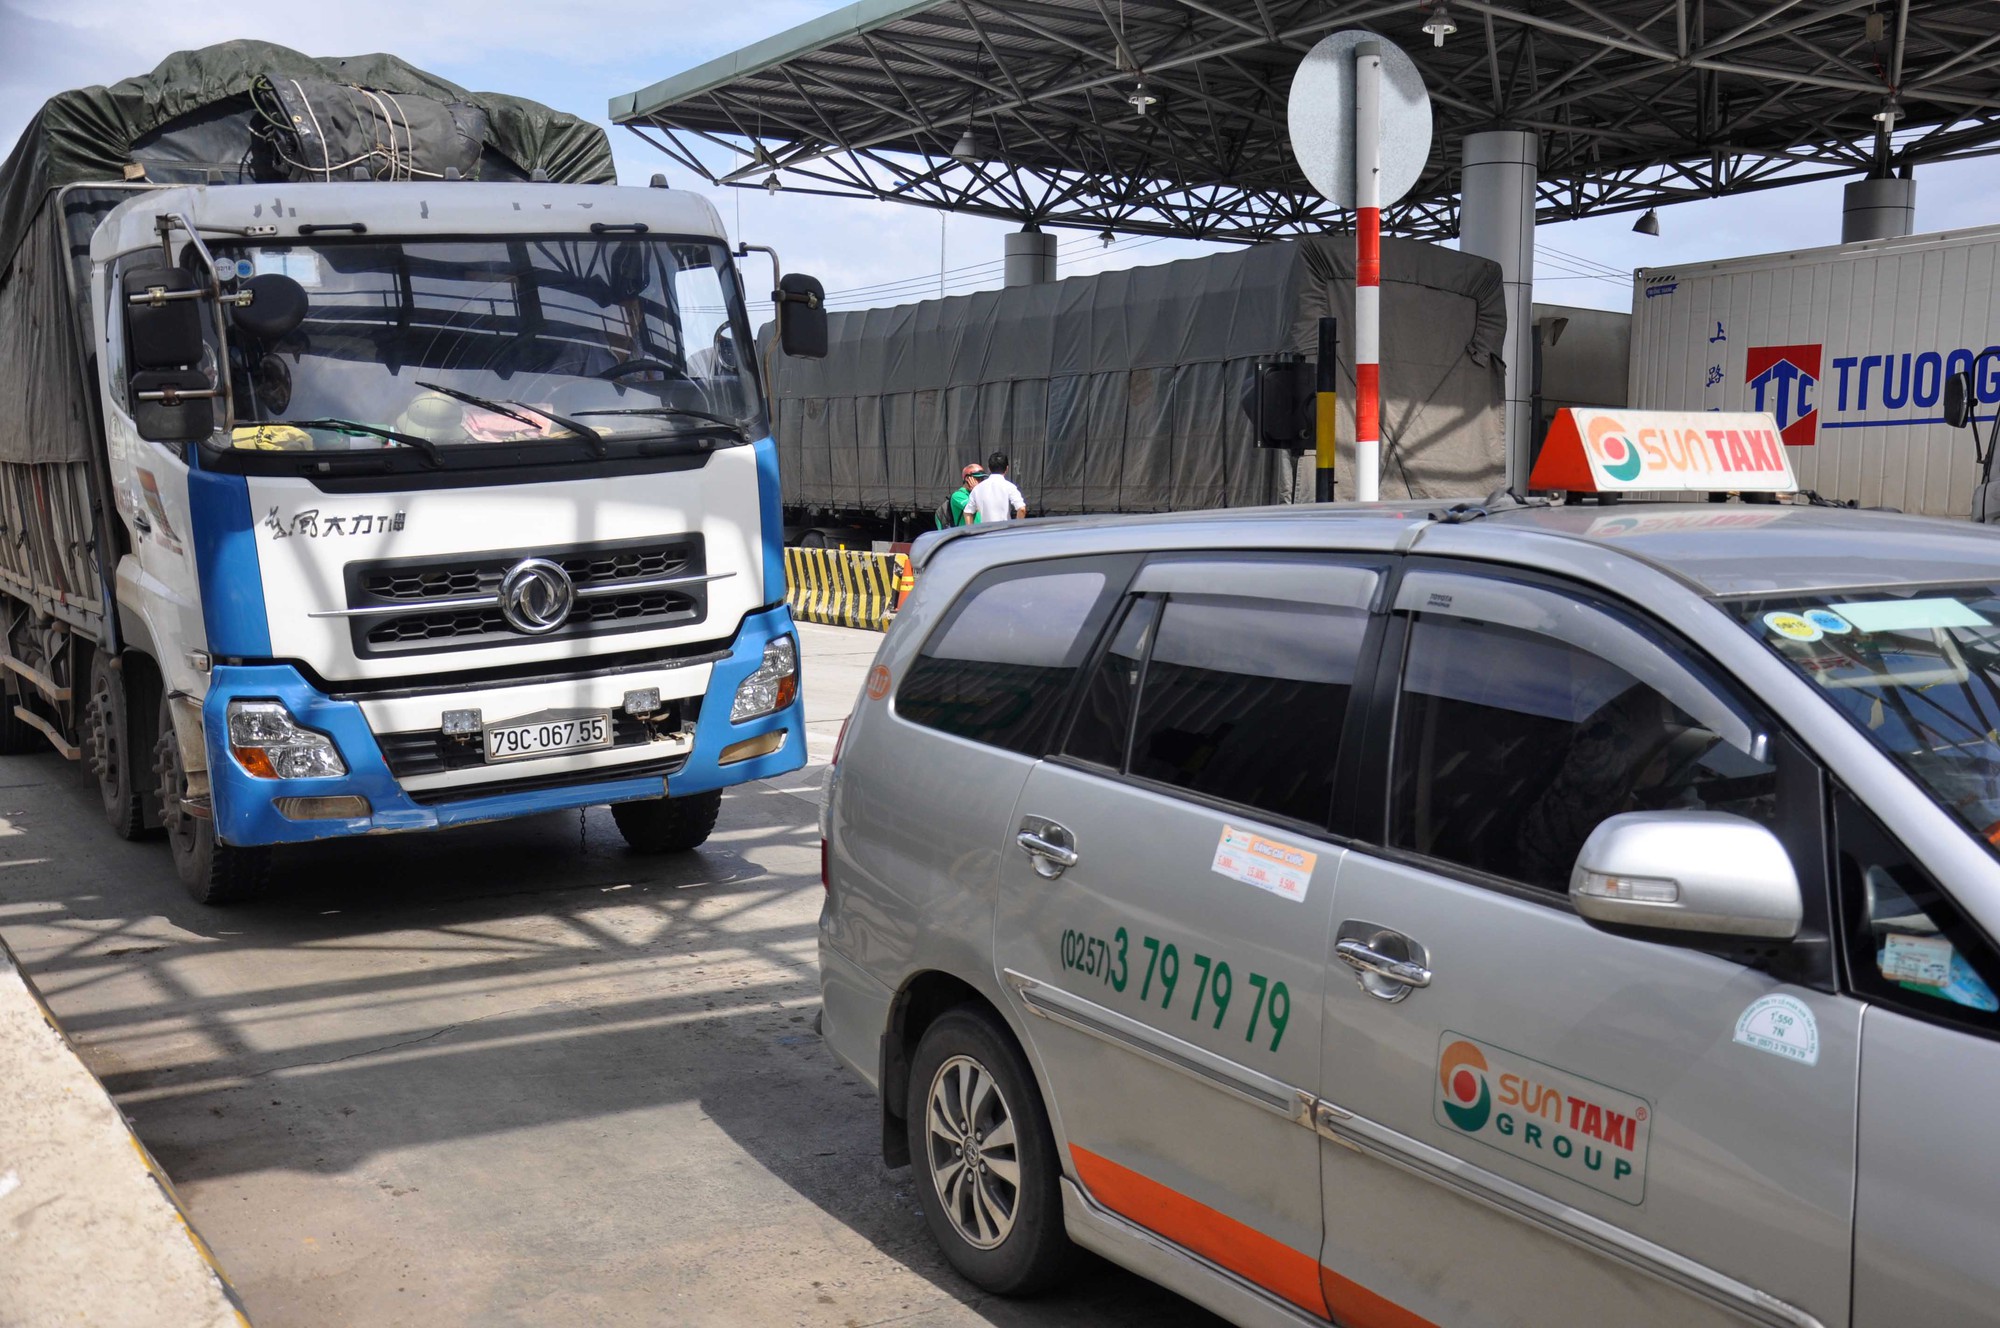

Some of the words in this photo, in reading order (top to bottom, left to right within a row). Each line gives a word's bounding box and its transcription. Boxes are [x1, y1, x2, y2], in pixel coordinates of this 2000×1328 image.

[1751, 359, 1814, 431] TTC
[1638, 428, 1712, 474] SUN
[1705, 430, 1784, 472] TAXI
[494, 720, 603, 754] 79C-067.55
[1140, 935, 1179, 1010] 79
[1191, 953, 1232, 1030] 79
[1245, 972, 1291, 1053] 79
[1496, 1112, 1632, 1180] GROUP
[1498, 1073, 1562, 1123] SUN
[1567, 1096, 1637, 1152] TAXI
